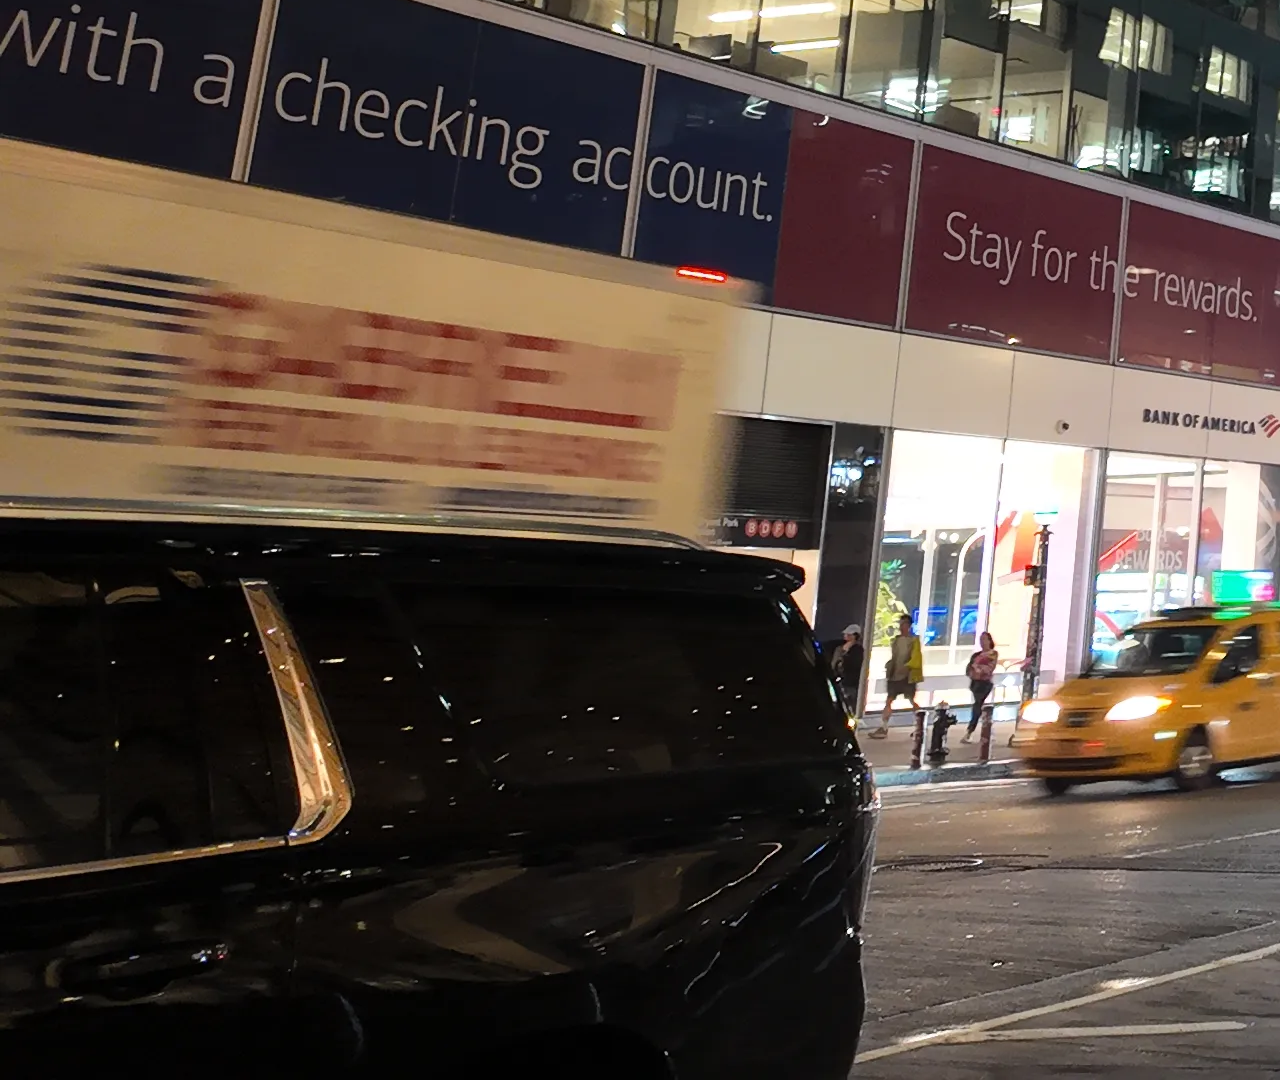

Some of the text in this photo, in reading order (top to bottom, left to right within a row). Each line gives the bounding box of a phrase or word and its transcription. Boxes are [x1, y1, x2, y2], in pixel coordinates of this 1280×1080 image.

[0, 3, 164, 92] with
[193, 53, 235, 108] a
[274, 58, 550, 189] checking
[943, 211, 1257, 322] Stay for the rewards.
[1142, 408, 1257, 435] BANK OF AMERICA
[1115, 548, 1183, 571] REWRDS
